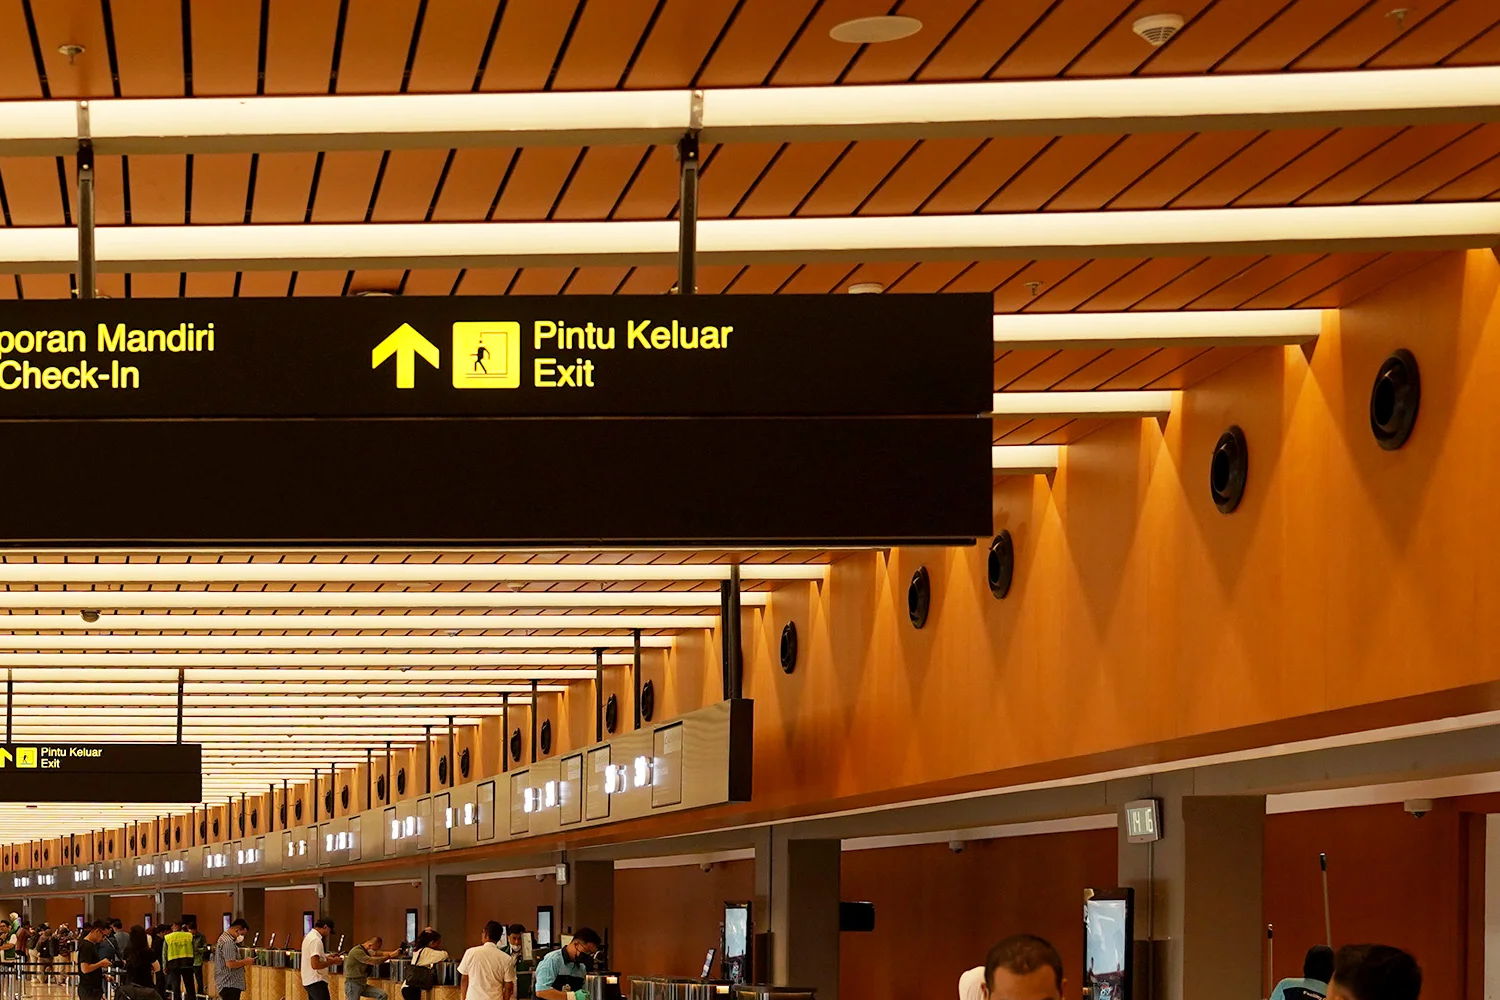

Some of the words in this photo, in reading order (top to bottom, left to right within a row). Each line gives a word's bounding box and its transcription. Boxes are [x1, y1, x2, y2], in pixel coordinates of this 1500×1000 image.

[97, 323, 215, 352] Mandiri
[533, 321, 616, 350] Pintu
[627, 320, 734, 350] Keluar
[534, 358, 595, 388] Exit
[40, 747, 67, 757] Pintu
[69, 747, 103, 758] Keluar
[40, 759, 61, 769] Exit
